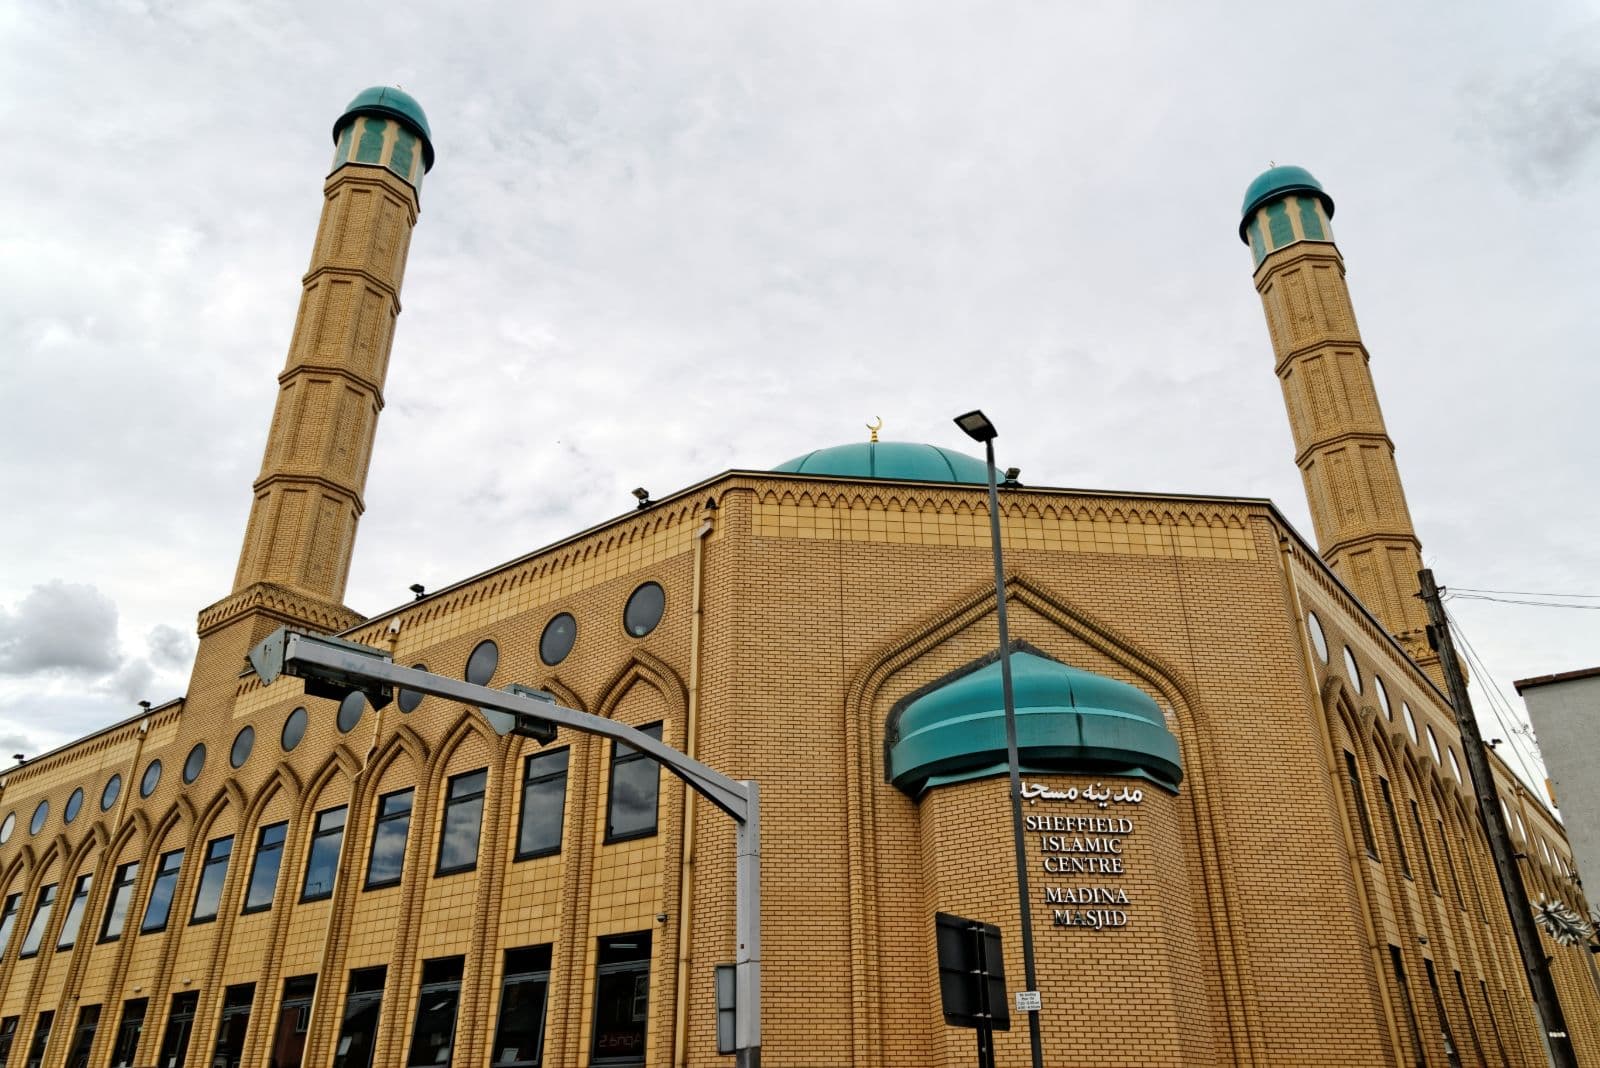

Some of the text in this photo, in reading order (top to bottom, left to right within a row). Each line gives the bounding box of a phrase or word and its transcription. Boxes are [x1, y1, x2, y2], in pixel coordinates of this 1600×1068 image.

[1026, 815, 1133, 833] SHEFFIELD
[1041, 835, 1122, 853] ISLAMIC
[1044, 856, 1124, 874] CENTRE
[1045, 887, 1130, 904] MADINA
[1053, 909, 1127, 930] MASJID
